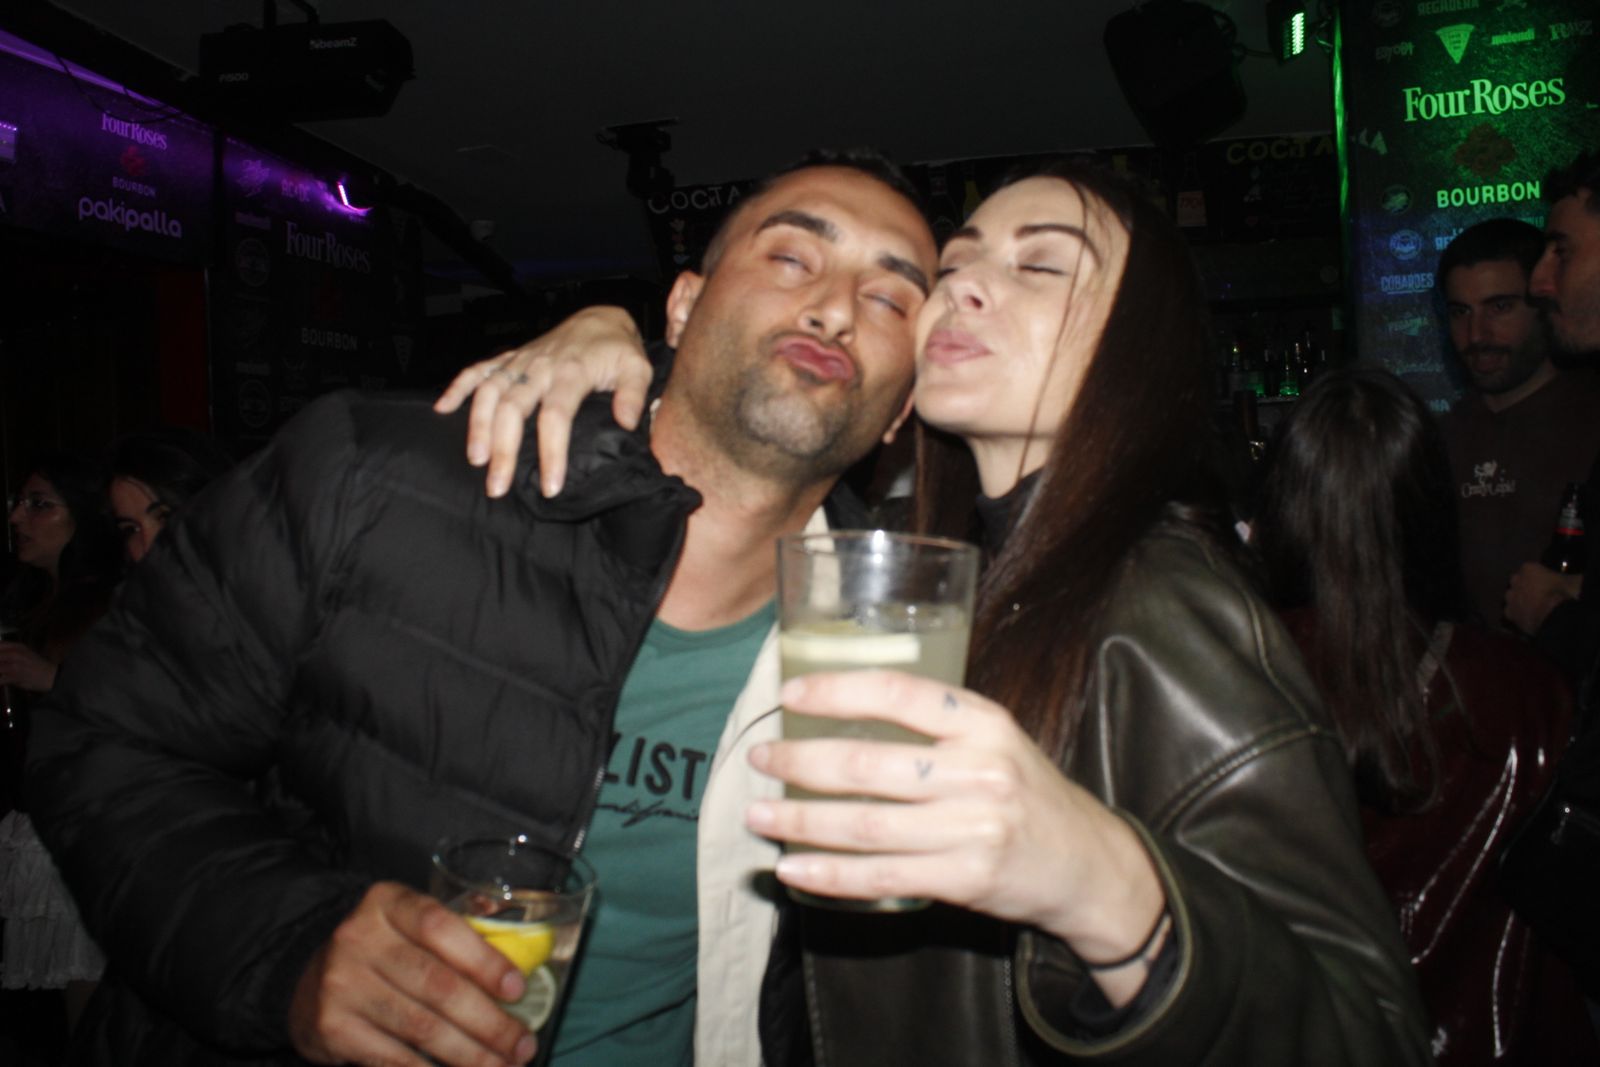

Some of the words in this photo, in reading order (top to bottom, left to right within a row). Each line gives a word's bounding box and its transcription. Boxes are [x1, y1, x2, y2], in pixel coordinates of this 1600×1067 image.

[1436, 180, 1541, 209] BOURBON
[78, 195, 183, 239] pakipalla
[301, 327, 358, 352] BOURBON
[605, 731, 714, 801] LIST
